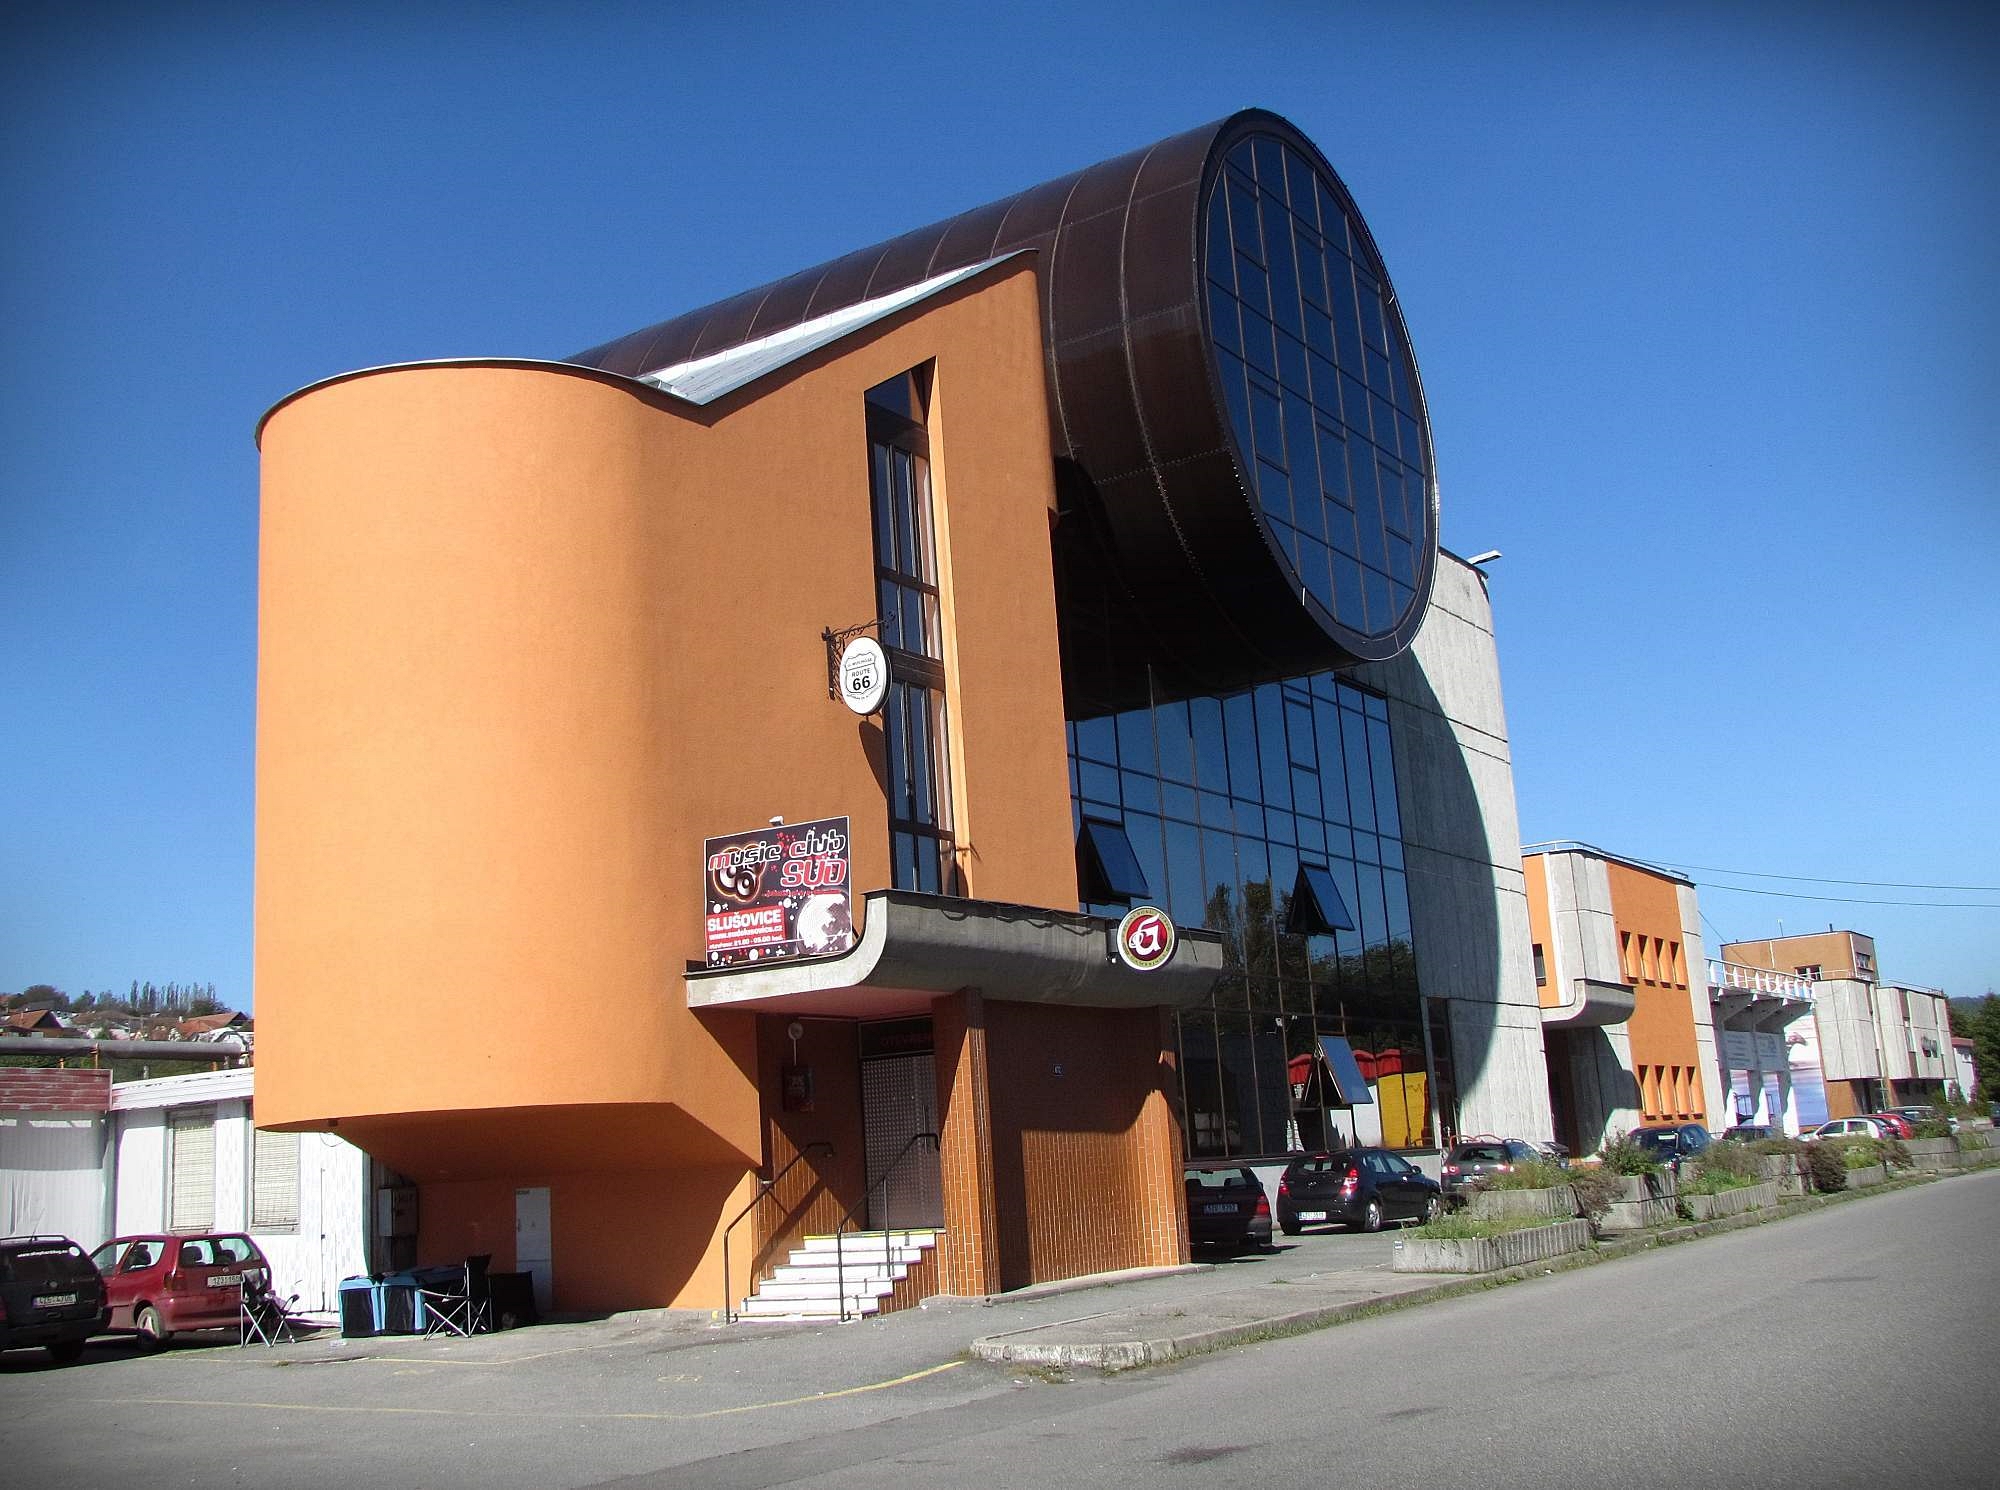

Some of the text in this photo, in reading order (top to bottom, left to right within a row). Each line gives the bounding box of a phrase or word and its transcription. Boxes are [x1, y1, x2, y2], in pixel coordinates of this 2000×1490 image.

[851, 668, 871, 677] ROUTE
[852, 675, 871, 691] 66
[708, 828, 847, 871] music club
[780, 858, 847, 887] SUD
[707, 909, 782, 931] SLUŠOVICE
